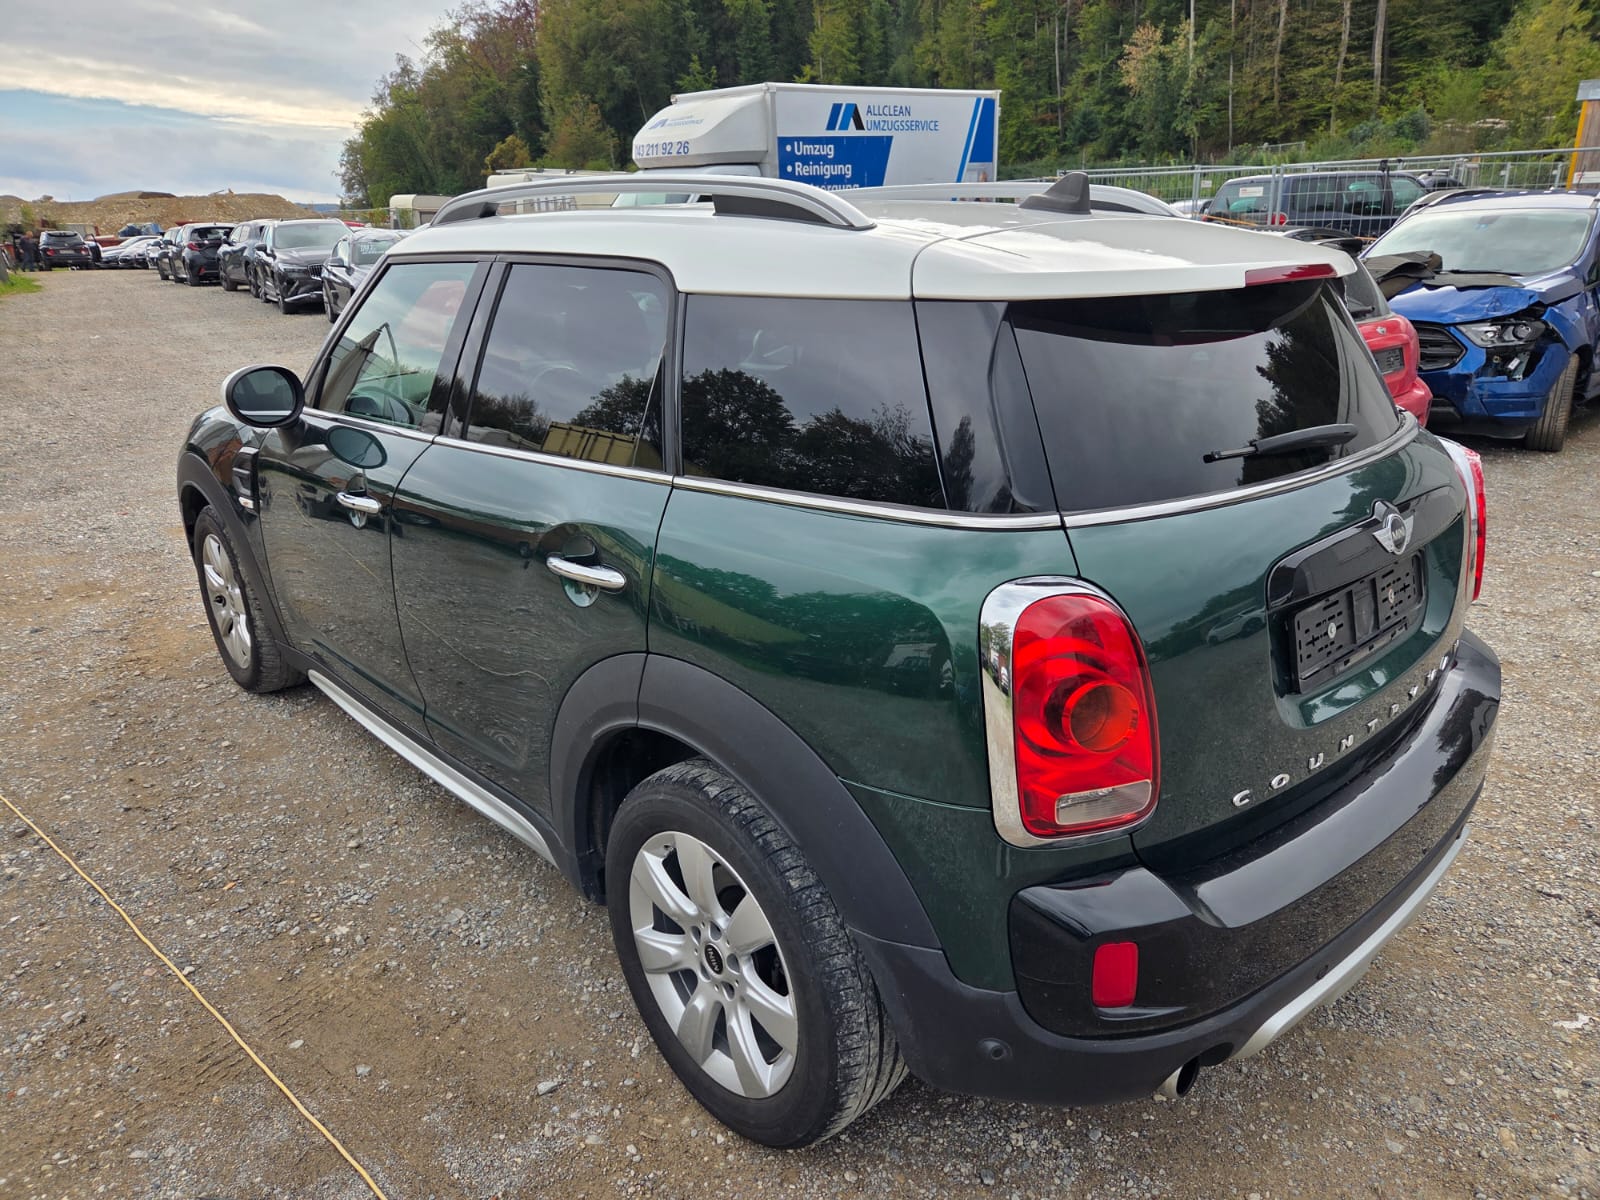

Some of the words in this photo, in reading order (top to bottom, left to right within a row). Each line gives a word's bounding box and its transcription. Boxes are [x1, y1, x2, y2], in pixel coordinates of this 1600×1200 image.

[866, 105, 911, 117] ALLCLEAN
[866, 120, 939, 131] UMZUGSSERVICE
[646, 143, 659, 156] 211
[661, 142, 674, 155] 92
[676, 141, 690, 154] 26
[794, 141, 834, 158] Umzug
[795, 161, 852, 178] Reinigung
